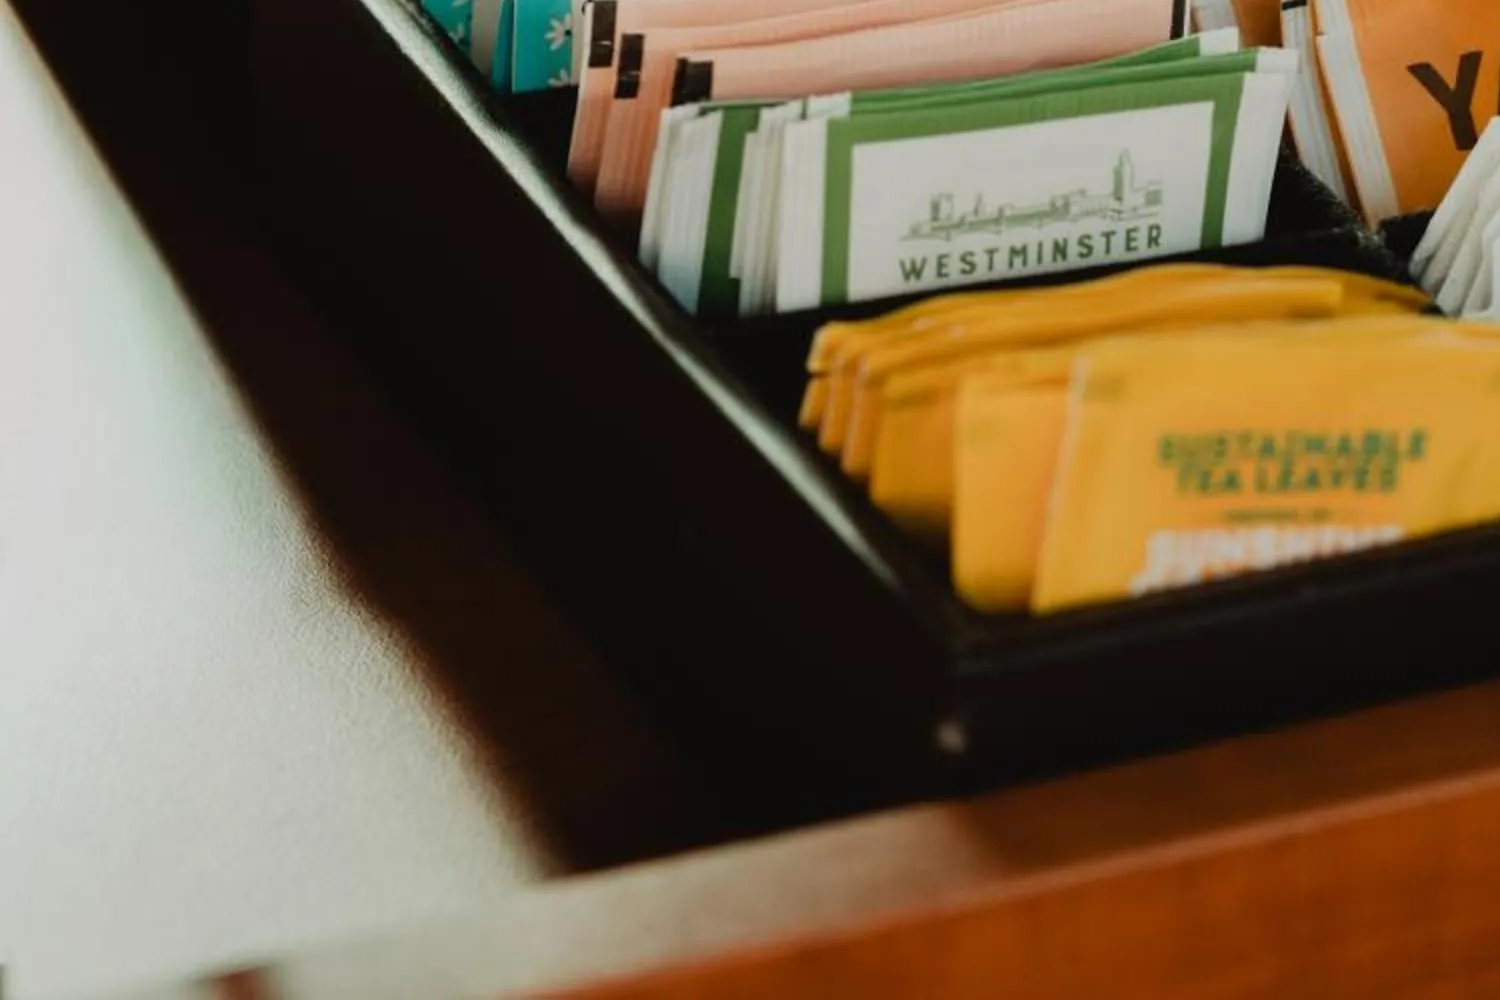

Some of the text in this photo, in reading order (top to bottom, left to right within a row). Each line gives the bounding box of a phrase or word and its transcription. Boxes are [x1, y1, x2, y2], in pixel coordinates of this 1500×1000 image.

[898, 224, 1163, 285] WESTMINSTER
[1157, 429, 1427, 468] SUSTAINABLE
[1176, 462, 1400, 493] TEA LEAVES
